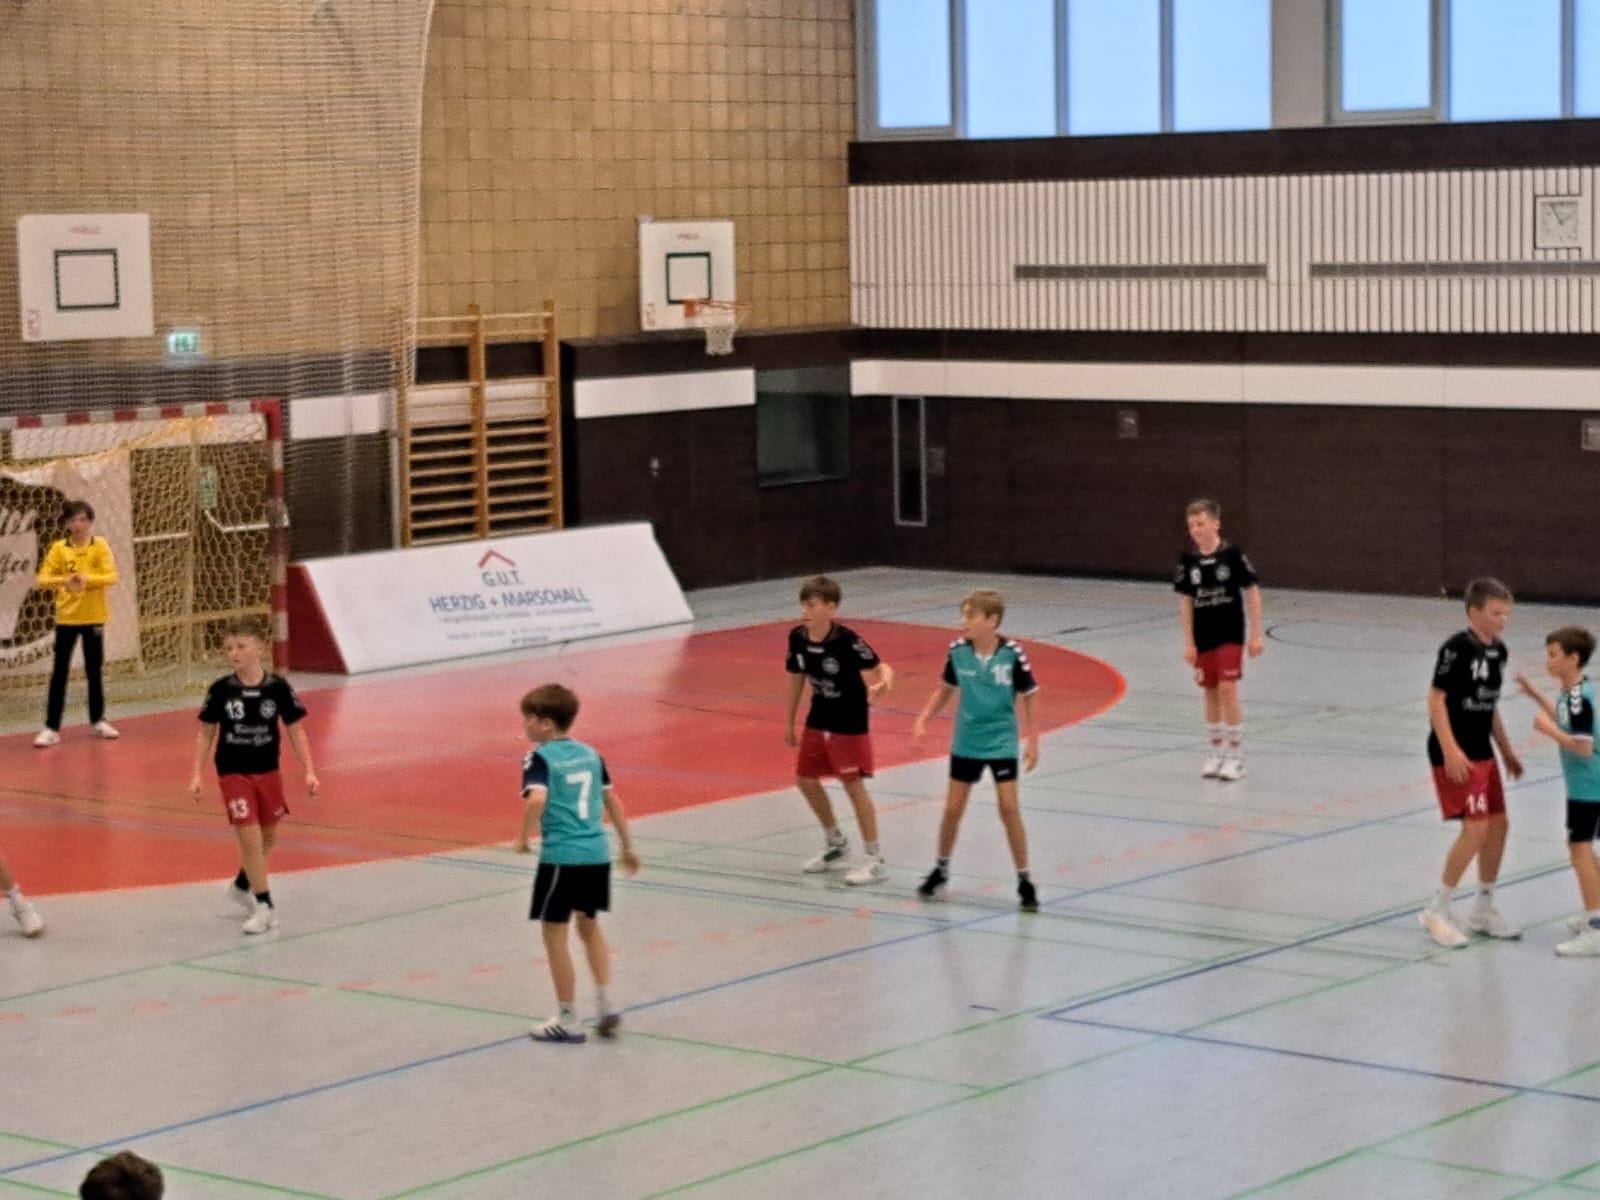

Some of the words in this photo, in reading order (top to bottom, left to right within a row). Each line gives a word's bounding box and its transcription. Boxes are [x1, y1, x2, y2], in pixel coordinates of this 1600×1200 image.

[430, 594, 486, 612] HERZIG
[502, 587, 590, 606] MARSCHALL
[1470, 658, 1489, 681] 14
[225, 700, 246, 719] 13
[565, 770, 593, 820] 7
[1465, 793, 1488, 815] 14
[230, 798, 248, 818] 13
